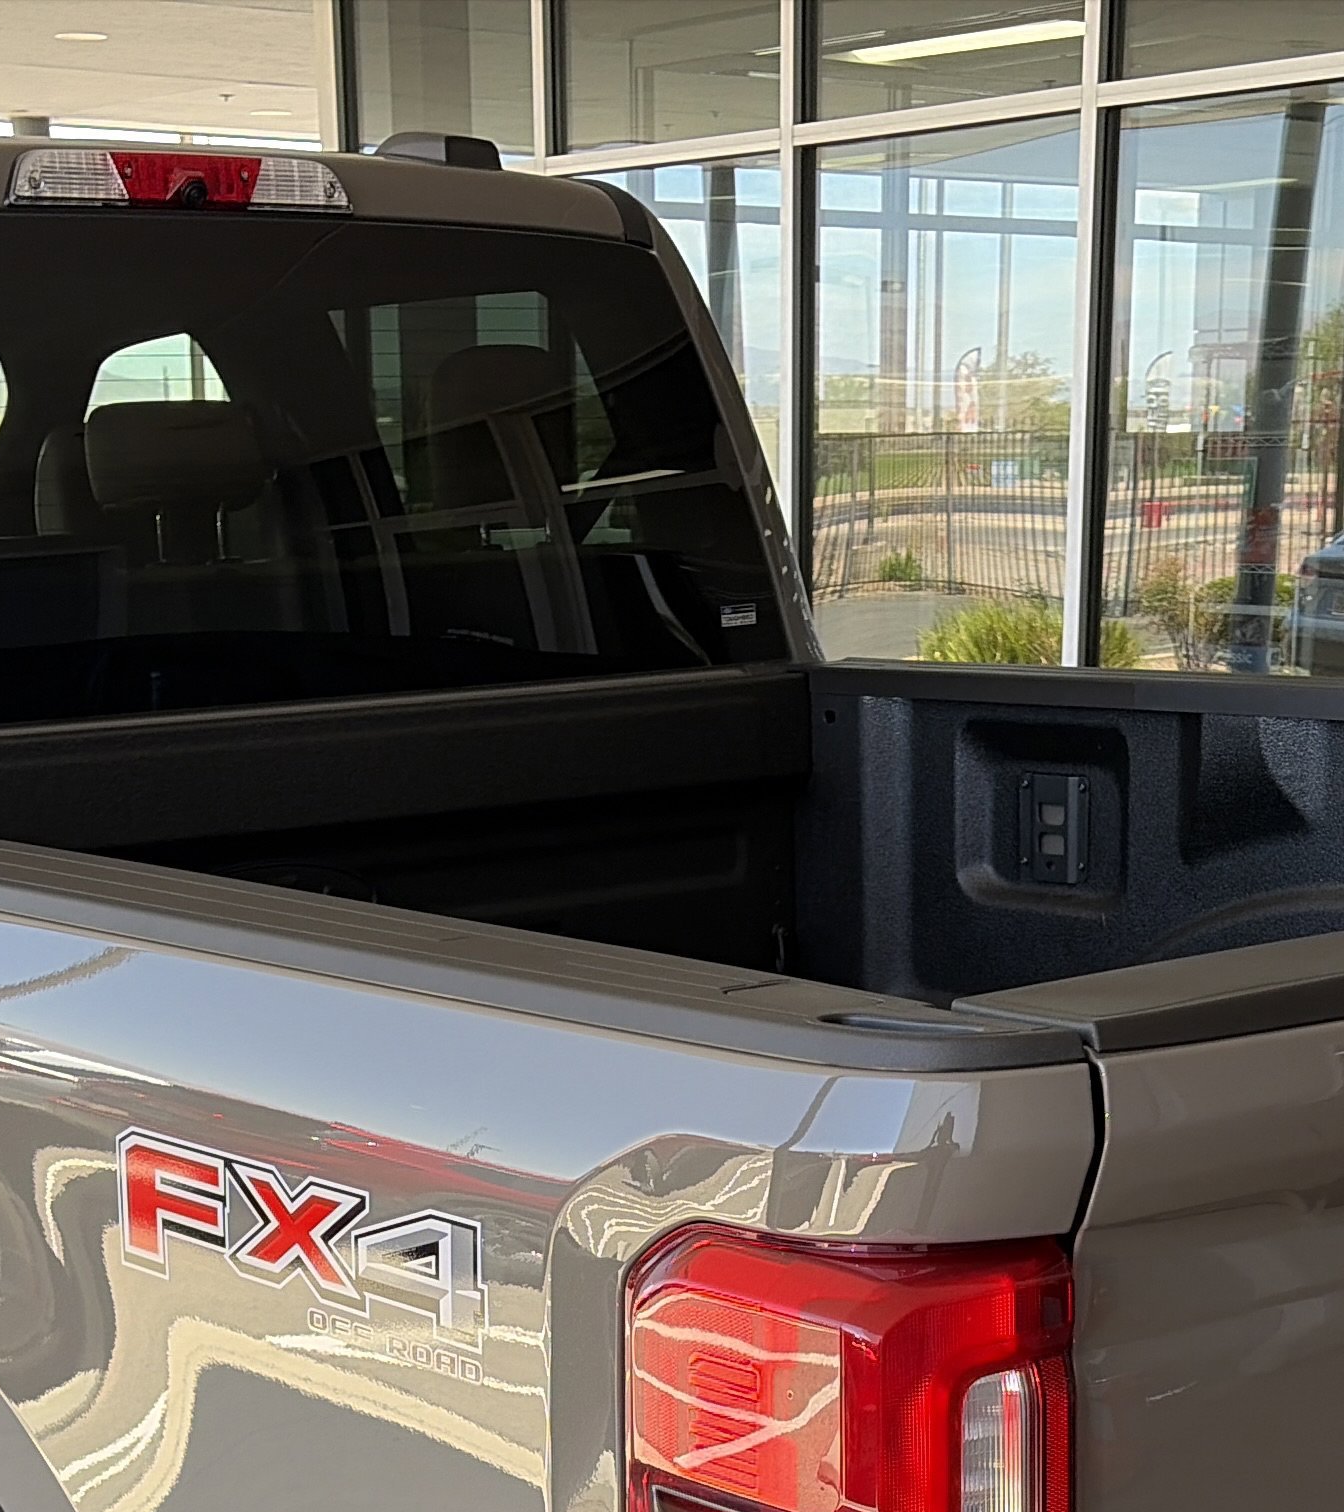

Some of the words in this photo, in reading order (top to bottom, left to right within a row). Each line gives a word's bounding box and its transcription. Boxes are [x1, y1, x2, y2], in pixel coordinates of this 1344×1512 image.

[116, 1125, 489, 1355] FX4
[307, 1307, 374, 1341] OFF
[385, 1332, 483, 1386] ROAD
